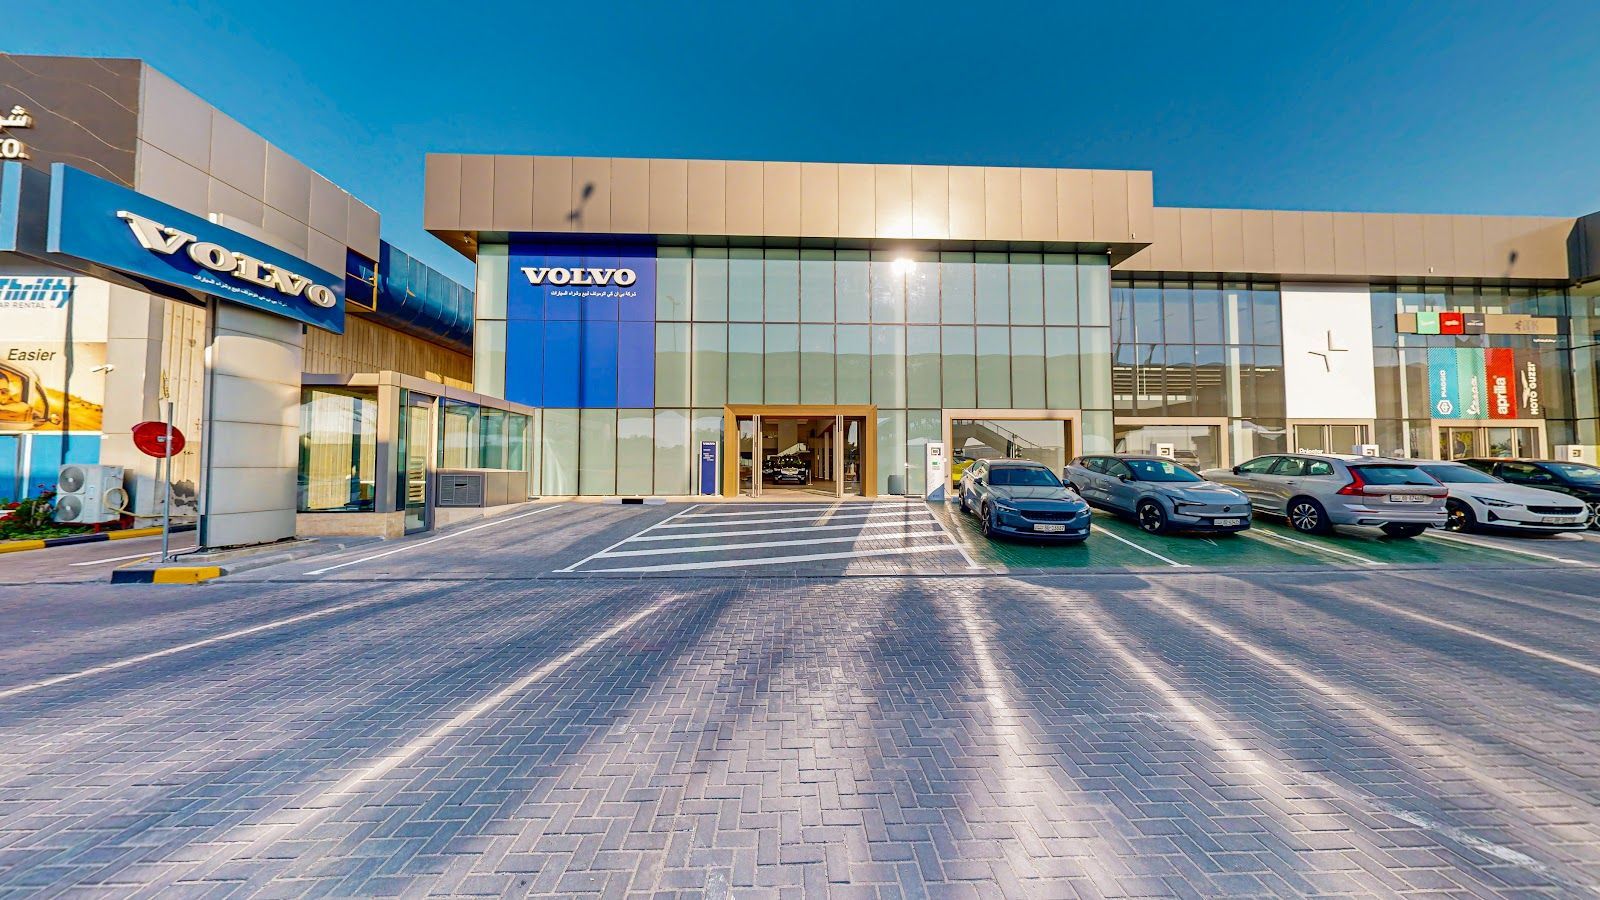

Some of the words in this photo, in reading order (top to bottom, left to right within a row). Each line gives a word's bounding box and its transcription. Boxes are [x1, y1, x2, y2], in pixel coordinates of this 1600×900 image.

[0, 138, 30, 159] O.
[116, 210, 337, 308] VOLVO
[520, 267, 637, 286] VOLVO
[7, 348, 56, 361] Easier
[1527, 361, 1537, 389] GUZZI
[1493, 377, 1510, 415] aprilia
[1529, 391, 1539, 415] MOTO
